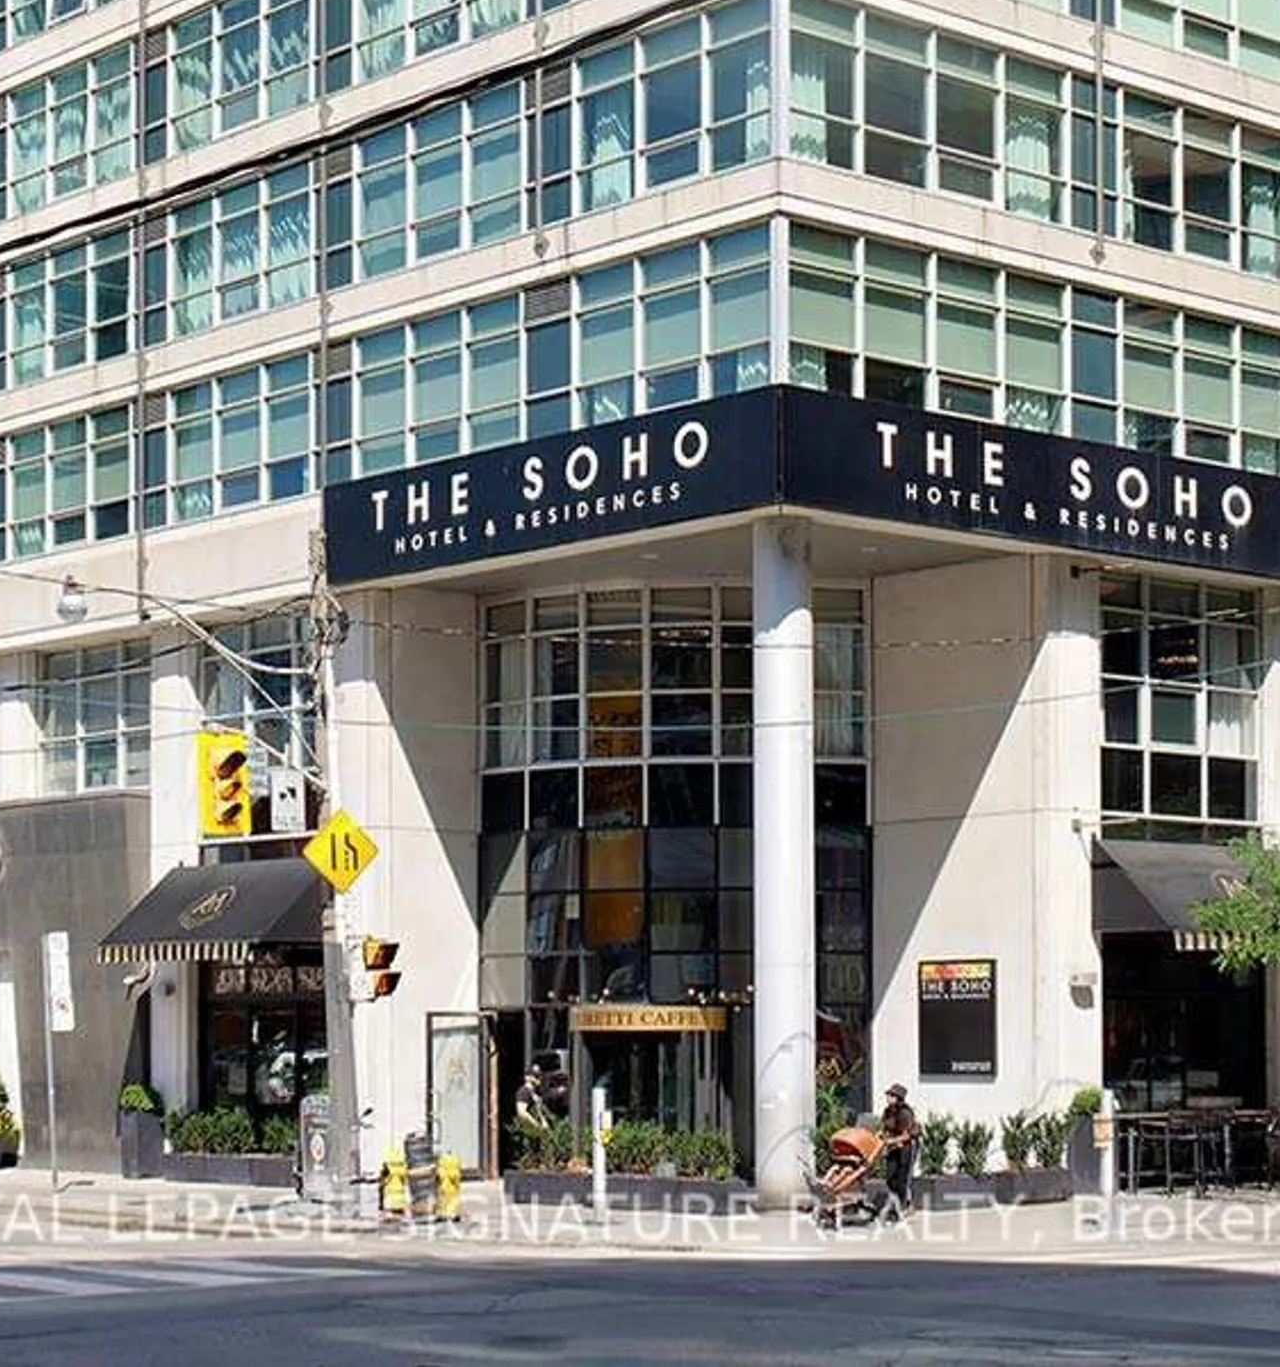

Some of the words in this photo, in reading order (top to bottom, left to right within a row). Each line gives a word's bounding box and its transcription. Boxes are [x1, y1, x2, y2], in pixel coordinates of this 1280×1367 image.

[371, 472, 469, 531] THE
[522, 420, 709, 501] SOHO
[395, 528, 468, 554] HOTEL
[484, 519, 496, 536] &
[515, 482, 681, 530] RESIDENCES
[876, 422, 1005, 487] THE
[1070, 456, 1253, 527] SOHO
[905, 482, 1000, 515] HOTEL
[1023, 501, 1038, 522] &
[1059, 507, 1230, 551] RESIDENCES
